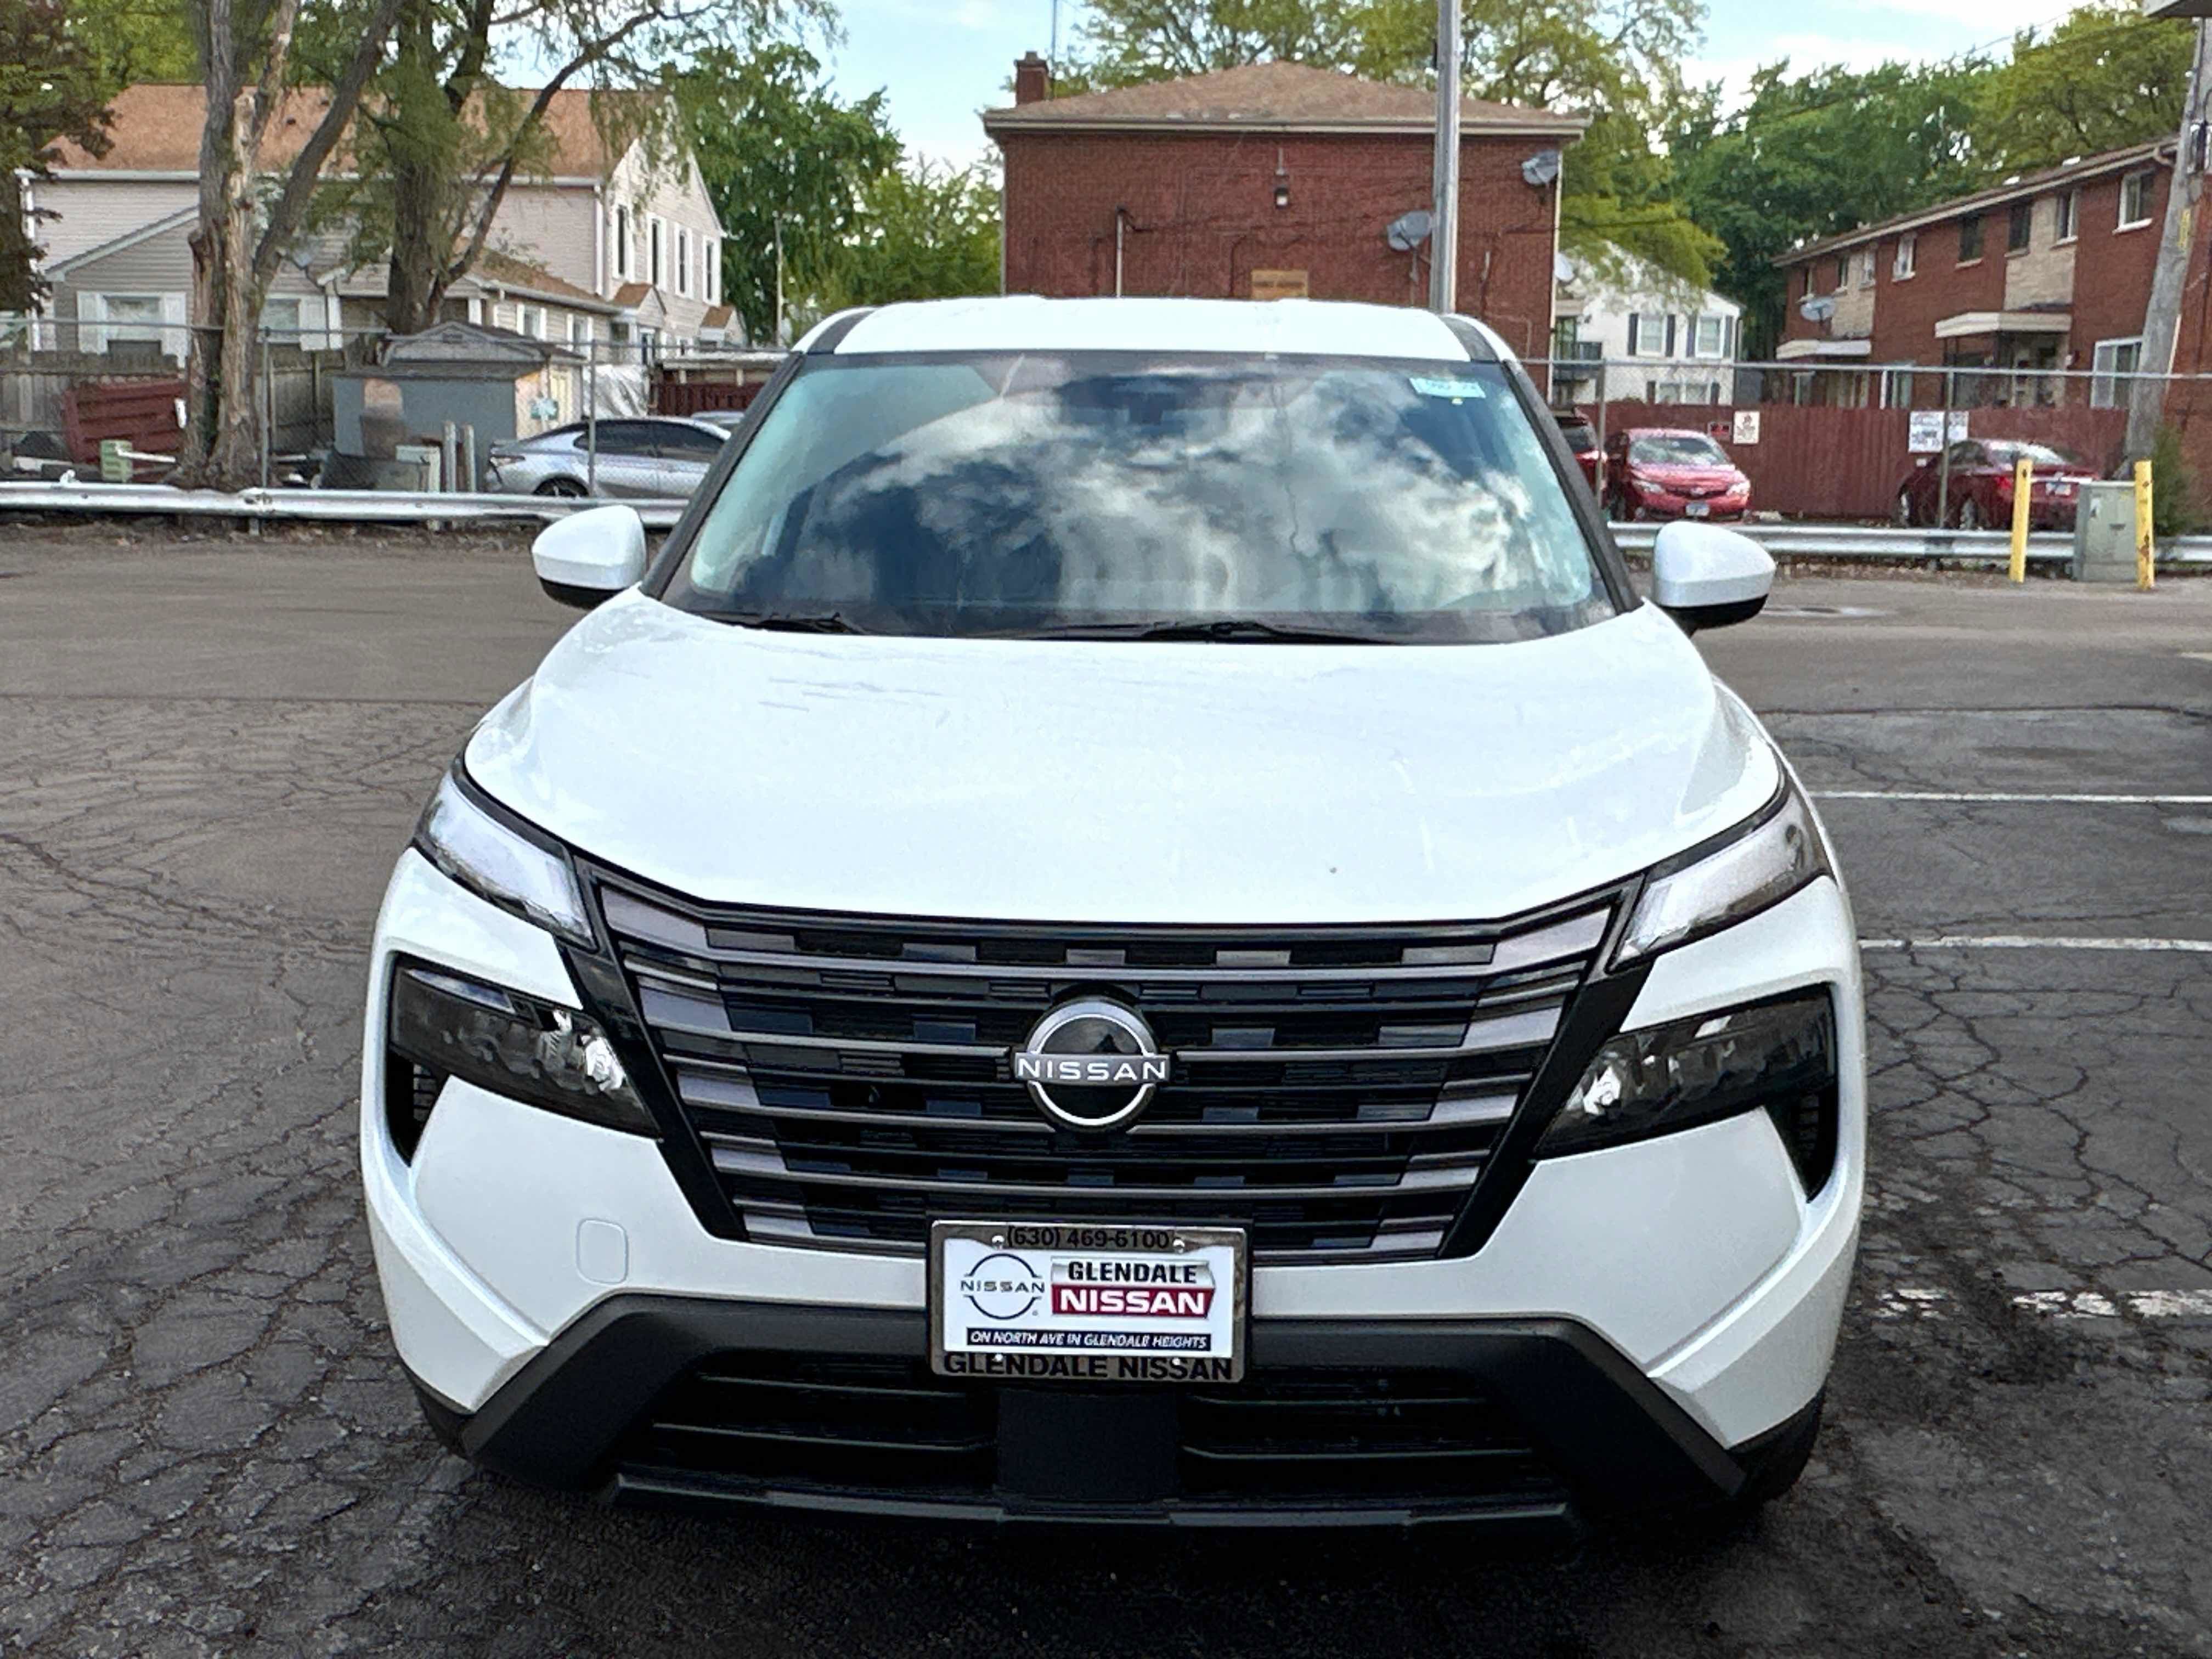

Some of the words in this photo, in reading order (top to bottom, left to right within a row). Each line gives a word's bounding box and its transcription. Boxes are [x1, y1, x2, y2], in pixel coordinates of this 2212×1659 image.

[1017, 1058, 1165, 1081] NISSAN
[1008, 1226, 1060, 1246] (630)
[1067, 1228, 1170, 1249] 469-6100
[1068, 1261, 1197, 1284] GLENDALE
[961, 1280, 1045, 1293] NISSAN
[1060, 1289, 1205, 1314] NISSAN
[970, 1330, 990, 1343] ON
[993, 1331, 1037, 1344] NORTH
[1040, 1333, 1064, 1345] AVE
[1066, 1333, 1081, 1346] IN
[1084, 1333, 1148, 1347] GLENDALE
[1152, 1335, 1207, 1348] HEIGHTS
[944, 1351, 1108, 1378] GLENDALE
[1118, 1356, 1232, 1380] NISSAN
